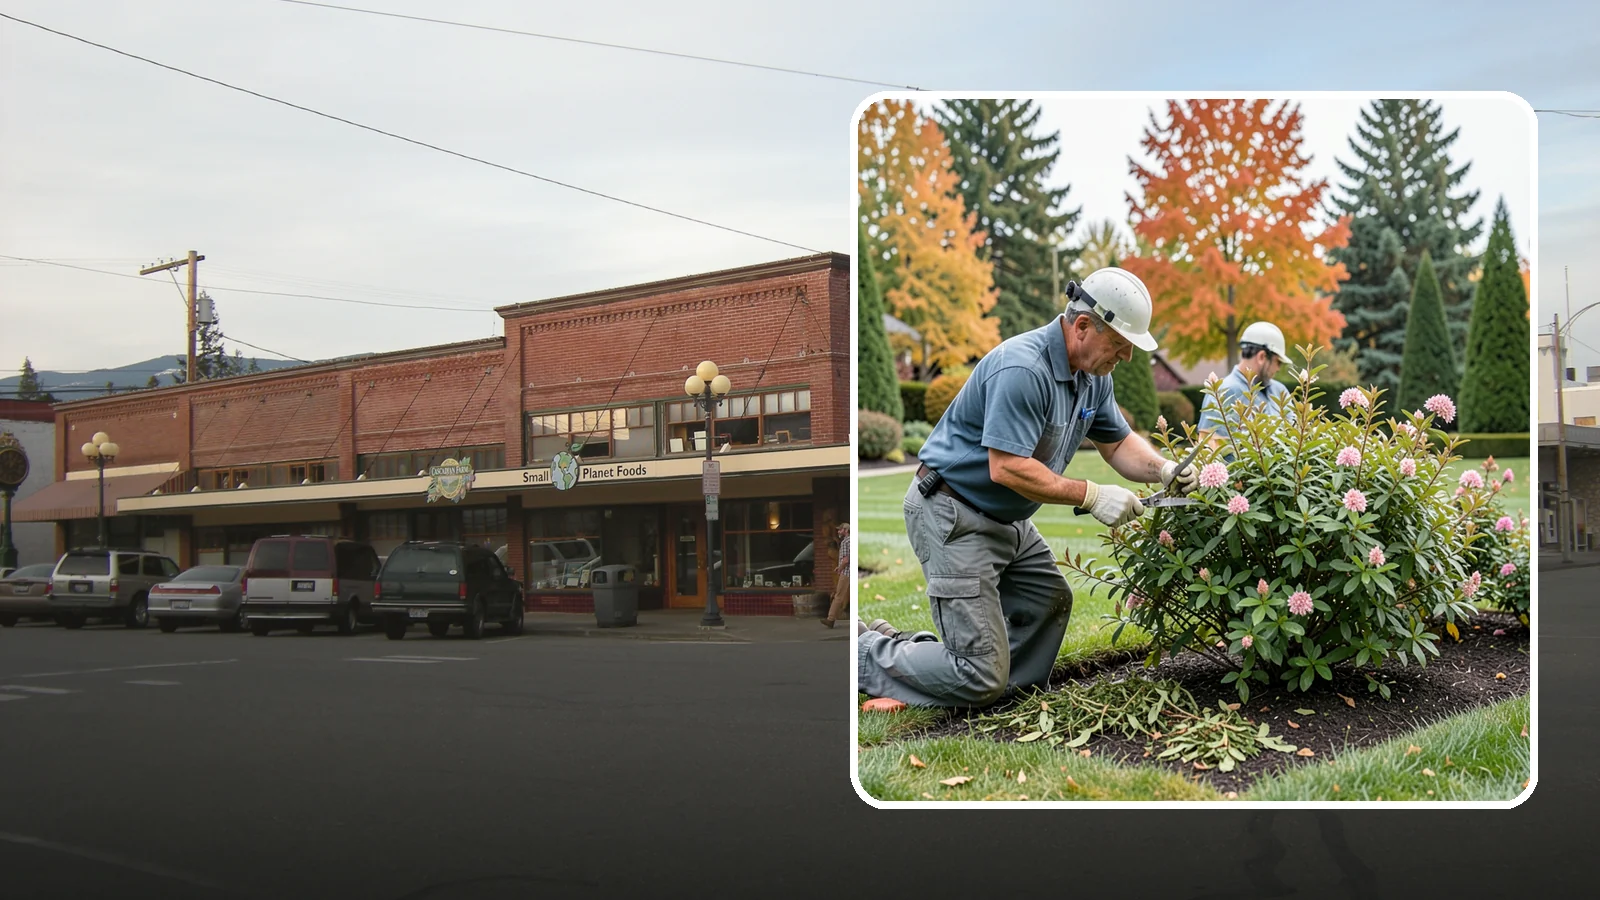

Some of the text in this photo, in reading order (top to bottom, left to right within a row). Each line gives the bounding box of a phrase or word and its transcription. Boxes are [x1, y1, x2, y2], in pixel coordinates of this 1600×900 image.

[523, 464, 647, 483] Small Planet Foods
